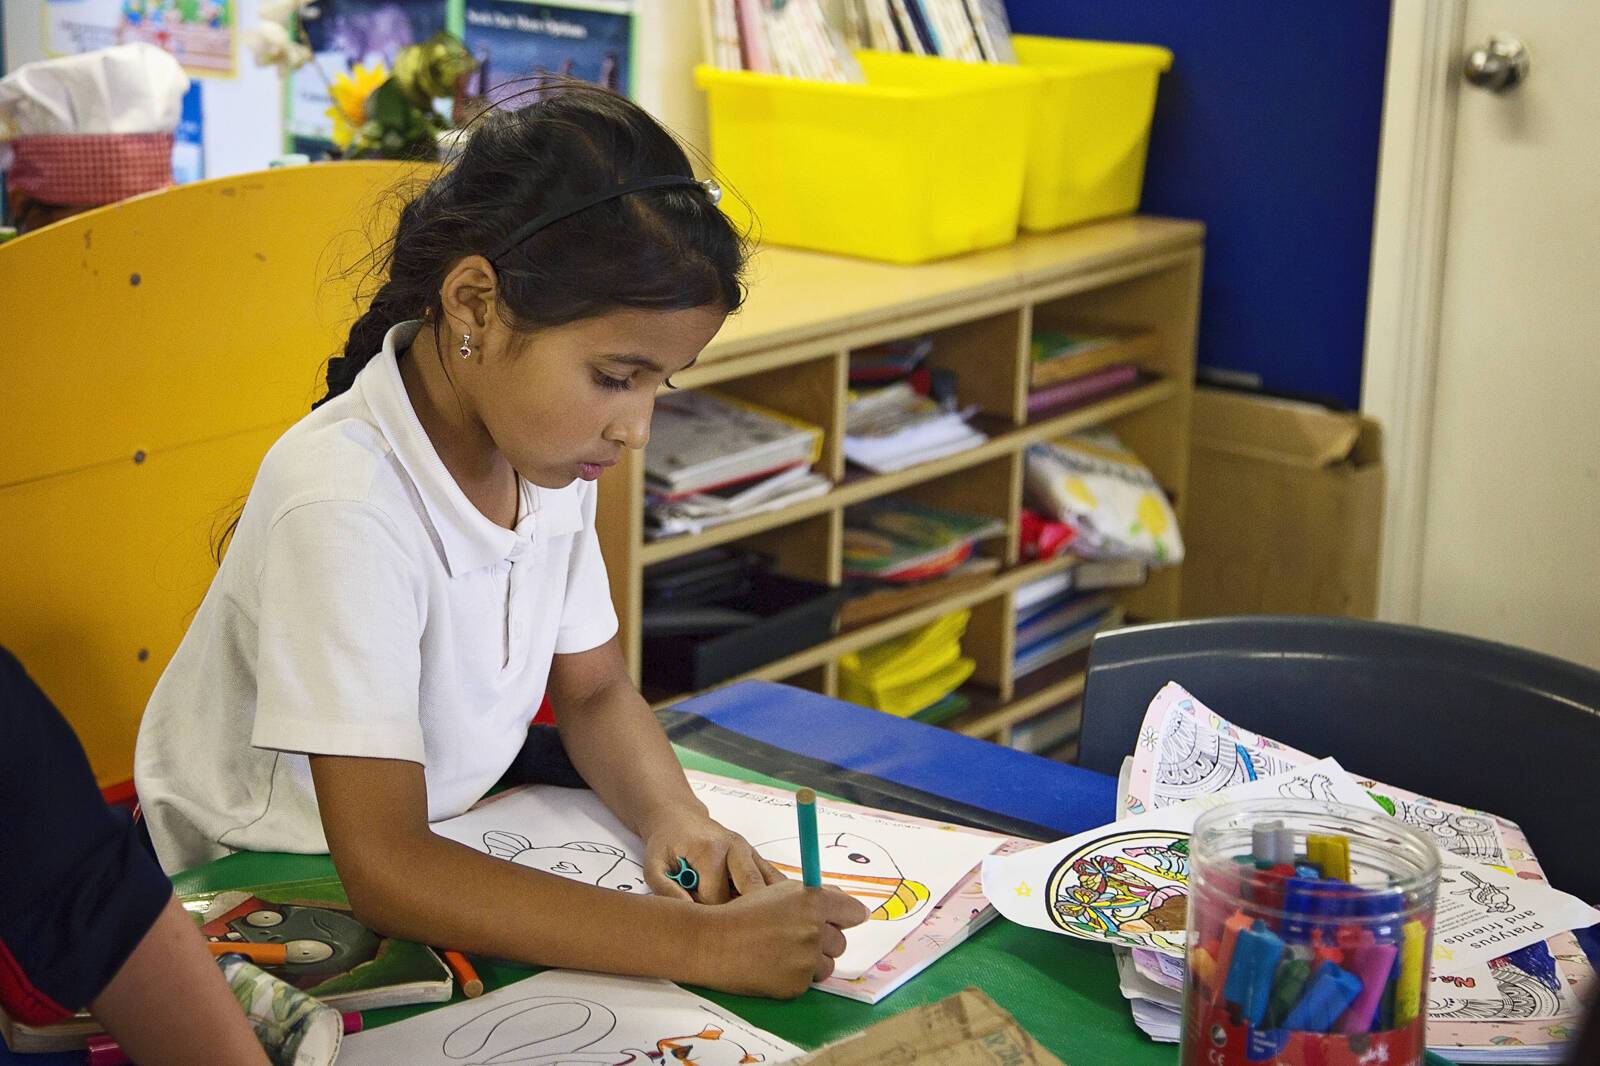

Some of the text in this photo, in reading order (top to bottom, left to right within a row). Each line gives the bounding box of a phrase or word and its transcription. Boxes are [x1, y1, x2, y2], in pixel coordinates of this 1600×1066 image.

[1505, 910, 1536, 924] and
[1444, 922, 1504, 944] friends
[1470, 922, 1544, 949] Platypus
